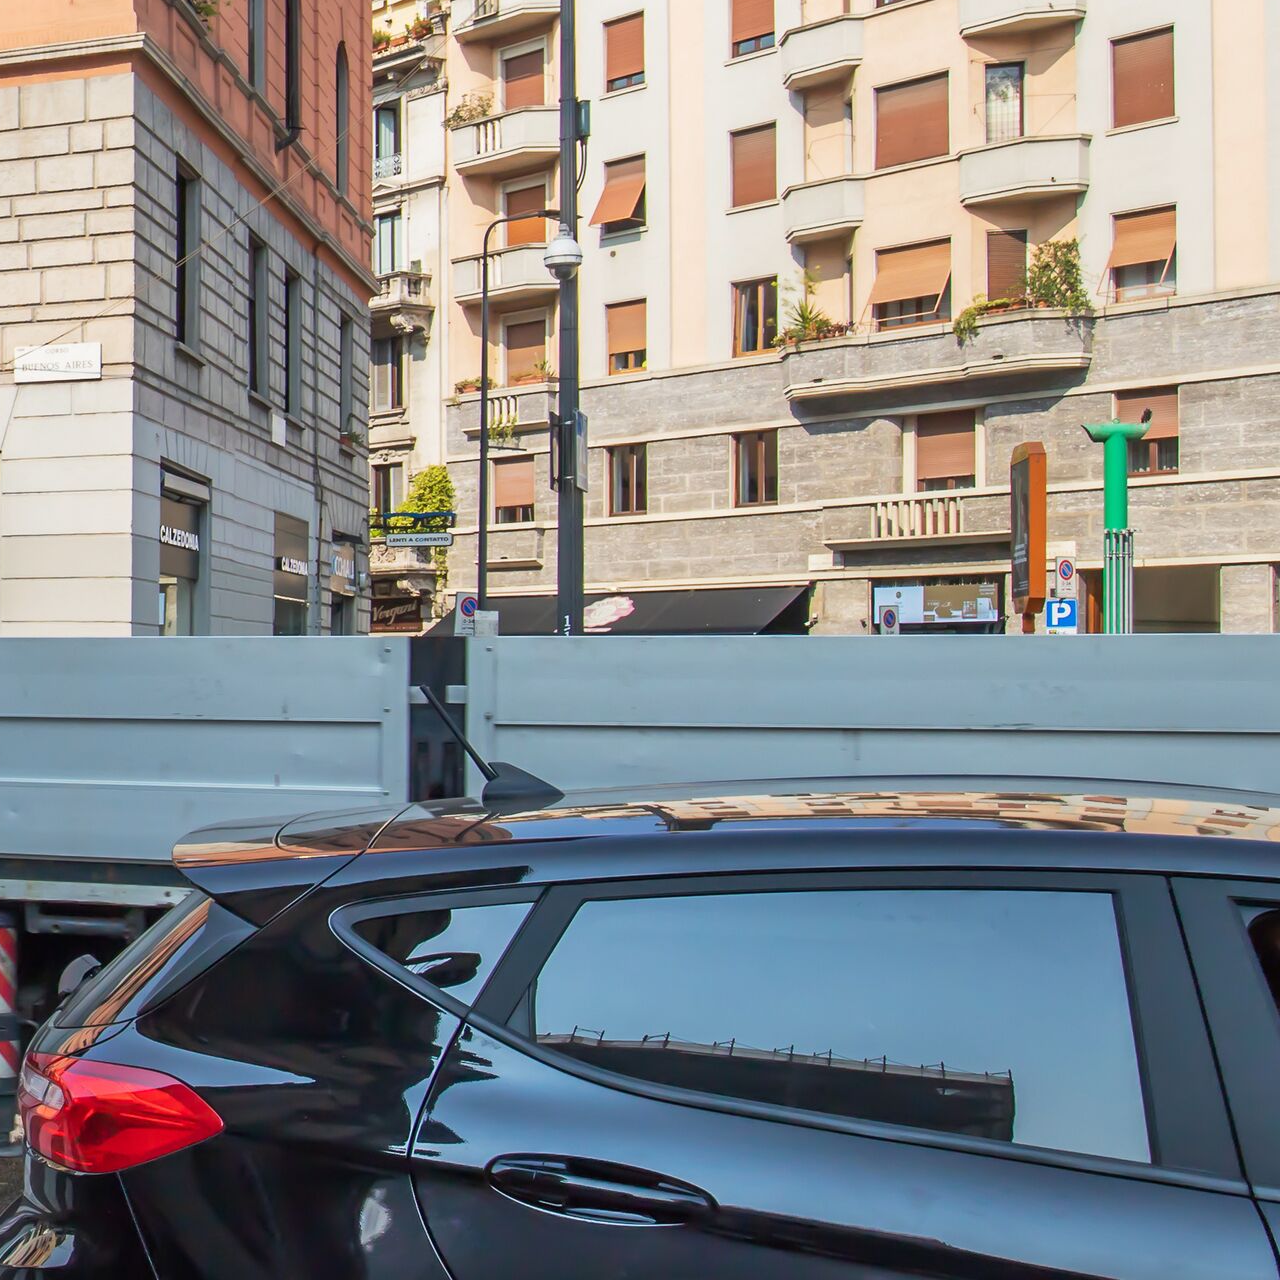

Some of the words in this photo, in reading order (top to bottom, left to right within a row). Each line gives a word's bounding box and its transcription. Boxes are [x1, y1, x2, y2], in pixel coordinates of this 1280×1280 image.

[22, 361, 60, 371] BUENOS
[65, 360, 93, 369] AIRES
[159, 524, 200, 552] CALZEDONIA
[281, 556, 309, 576] CALZEDONIA
[372, 600, 418, 626] Vergani
[1051, 602, 1071, 625] P
